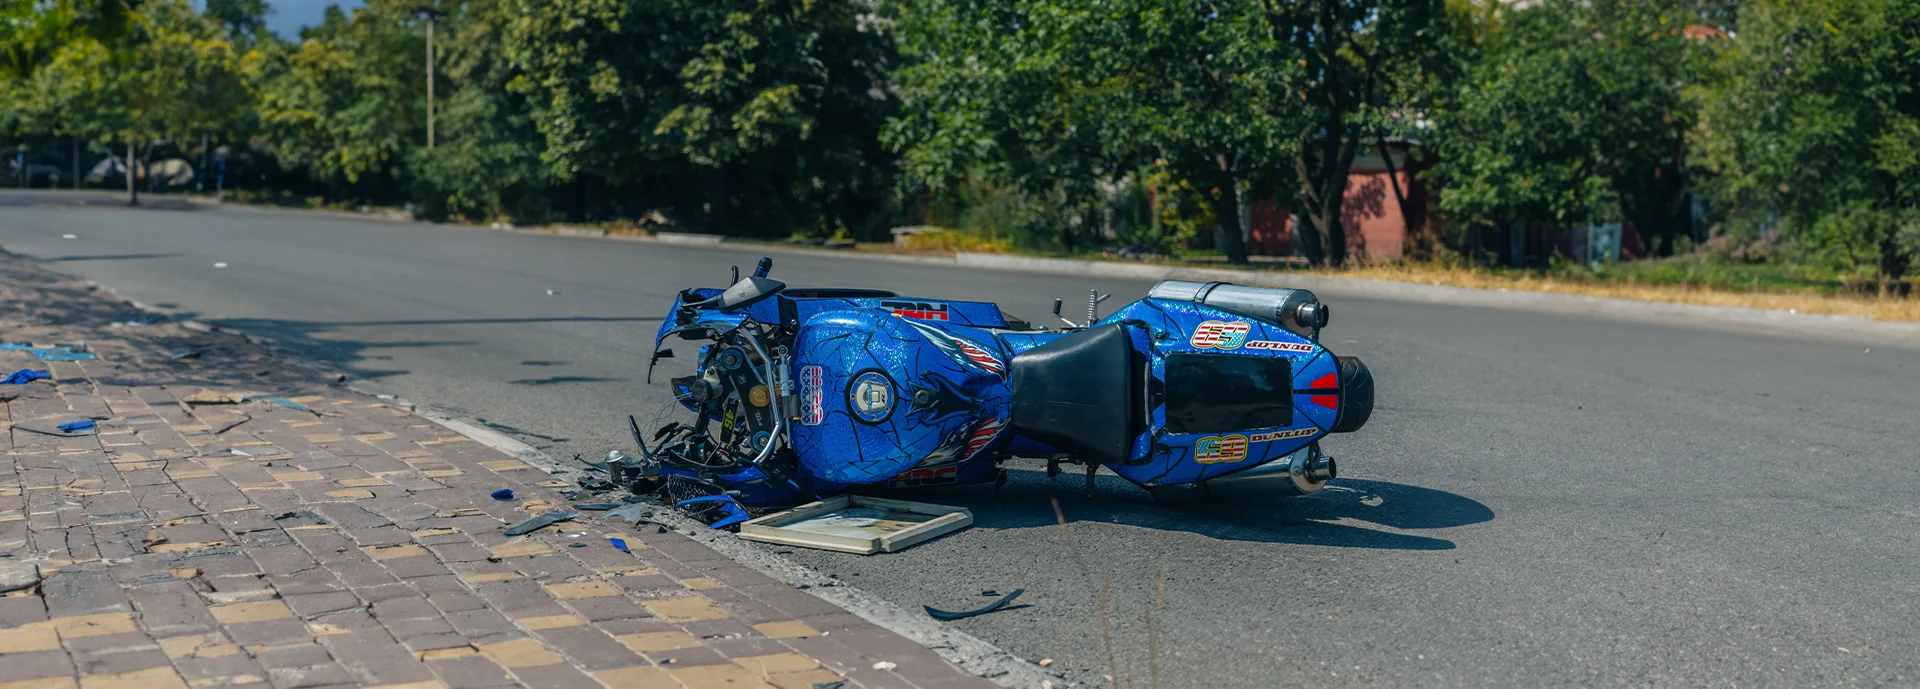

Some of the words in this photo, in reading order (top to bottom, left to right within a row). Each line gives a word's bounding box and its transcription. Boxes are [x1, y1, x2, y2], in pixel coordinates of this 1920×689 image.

[1192, 321, 1250, 349] 69
[1247, 341, 1314, 351] DUNLOP
[725, 409, 734, 430] 46
[1251, 428, 1317, 442] DUNLOP
[1195, 436, 1247, 462] 69
